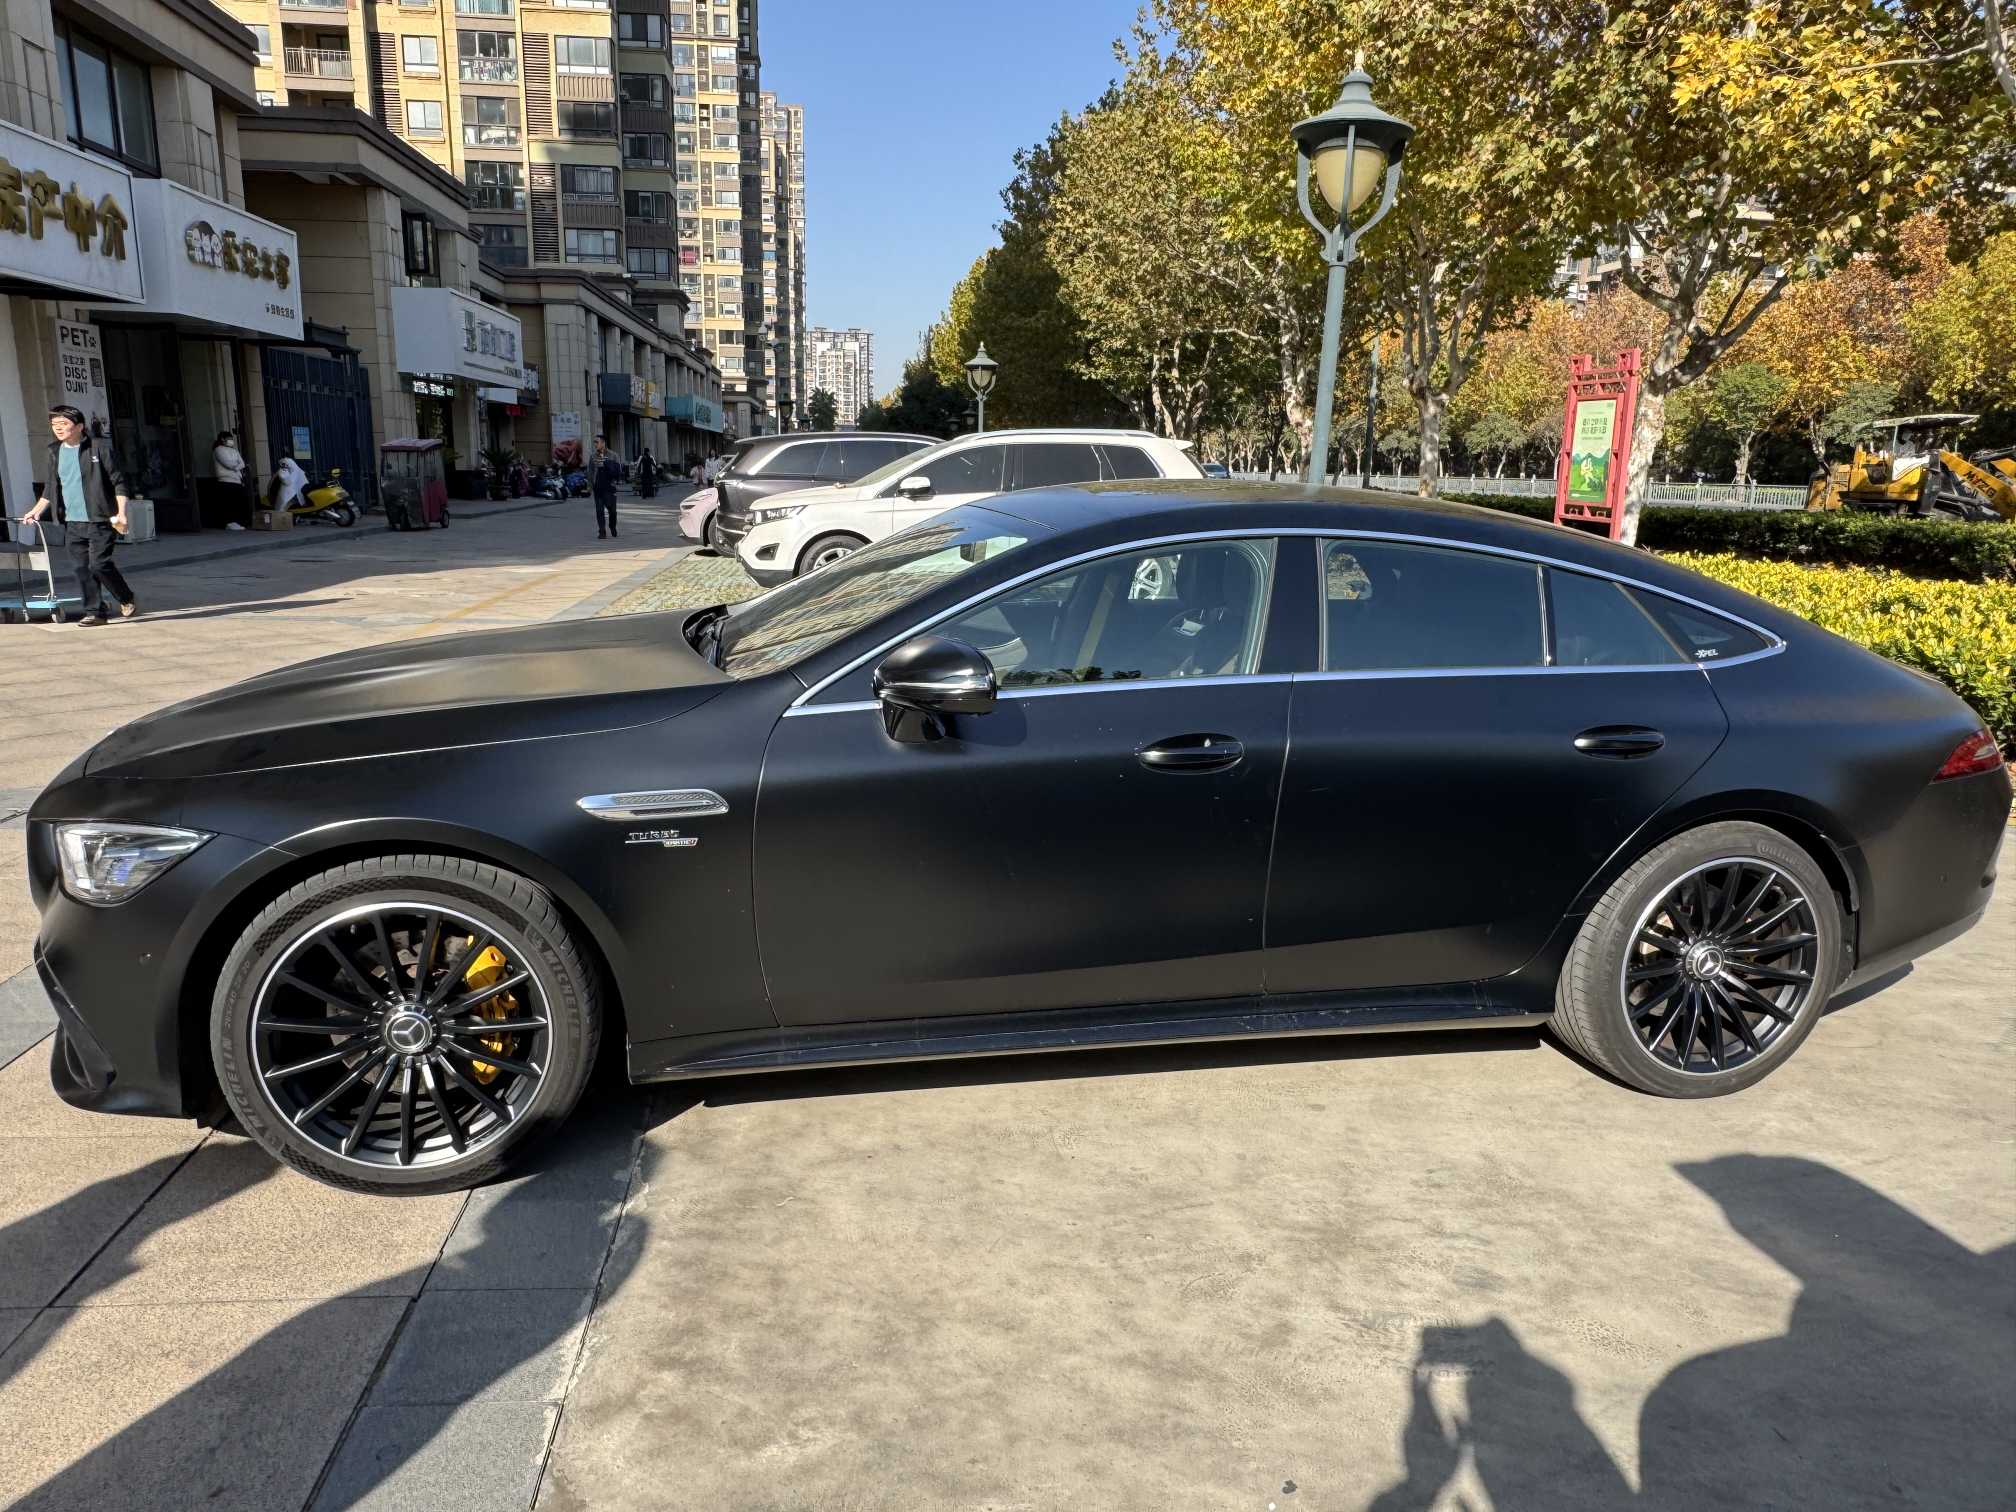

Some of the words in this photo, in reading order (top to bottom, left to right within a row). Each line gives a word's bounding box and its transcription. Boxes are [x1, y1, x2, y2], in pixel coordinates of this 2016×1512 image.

[60, 326, 89, 347] PET
[64, 366, 88, 380] DISC
[65, 379, 88, 394] OUNT
[629, 829, 680, 840] TURBO
[222, 1038, 263, 1130] MICHELIN
